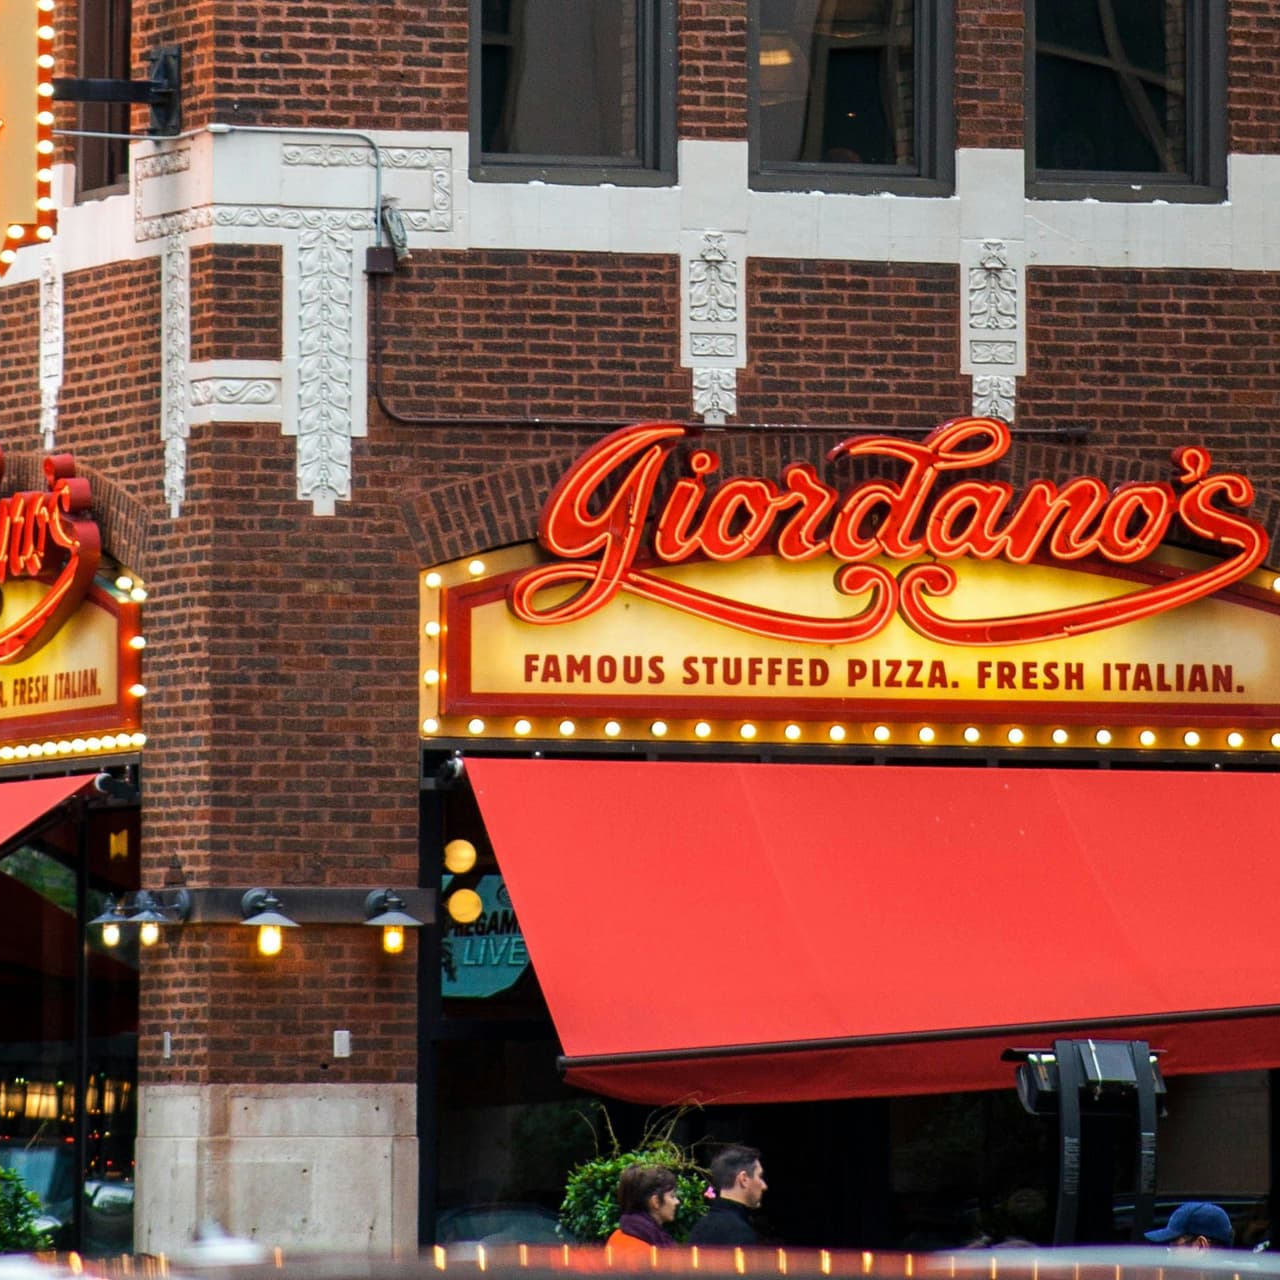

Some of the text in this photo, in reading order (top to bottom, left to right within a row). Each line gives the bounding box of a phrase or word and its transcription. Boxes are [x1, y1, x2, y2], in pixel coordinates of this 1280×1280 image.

[507, 416, 1271, 647] Giordano's
[12, 675, 49, 707] FRESH
[53, 668, 102, 701] ITALIAN.
[524, 653, 1246, 694] FAMOUS STUFFED PIZZA. FRESH ITALIAN.
[463, 936, 526, 966] LIVE
